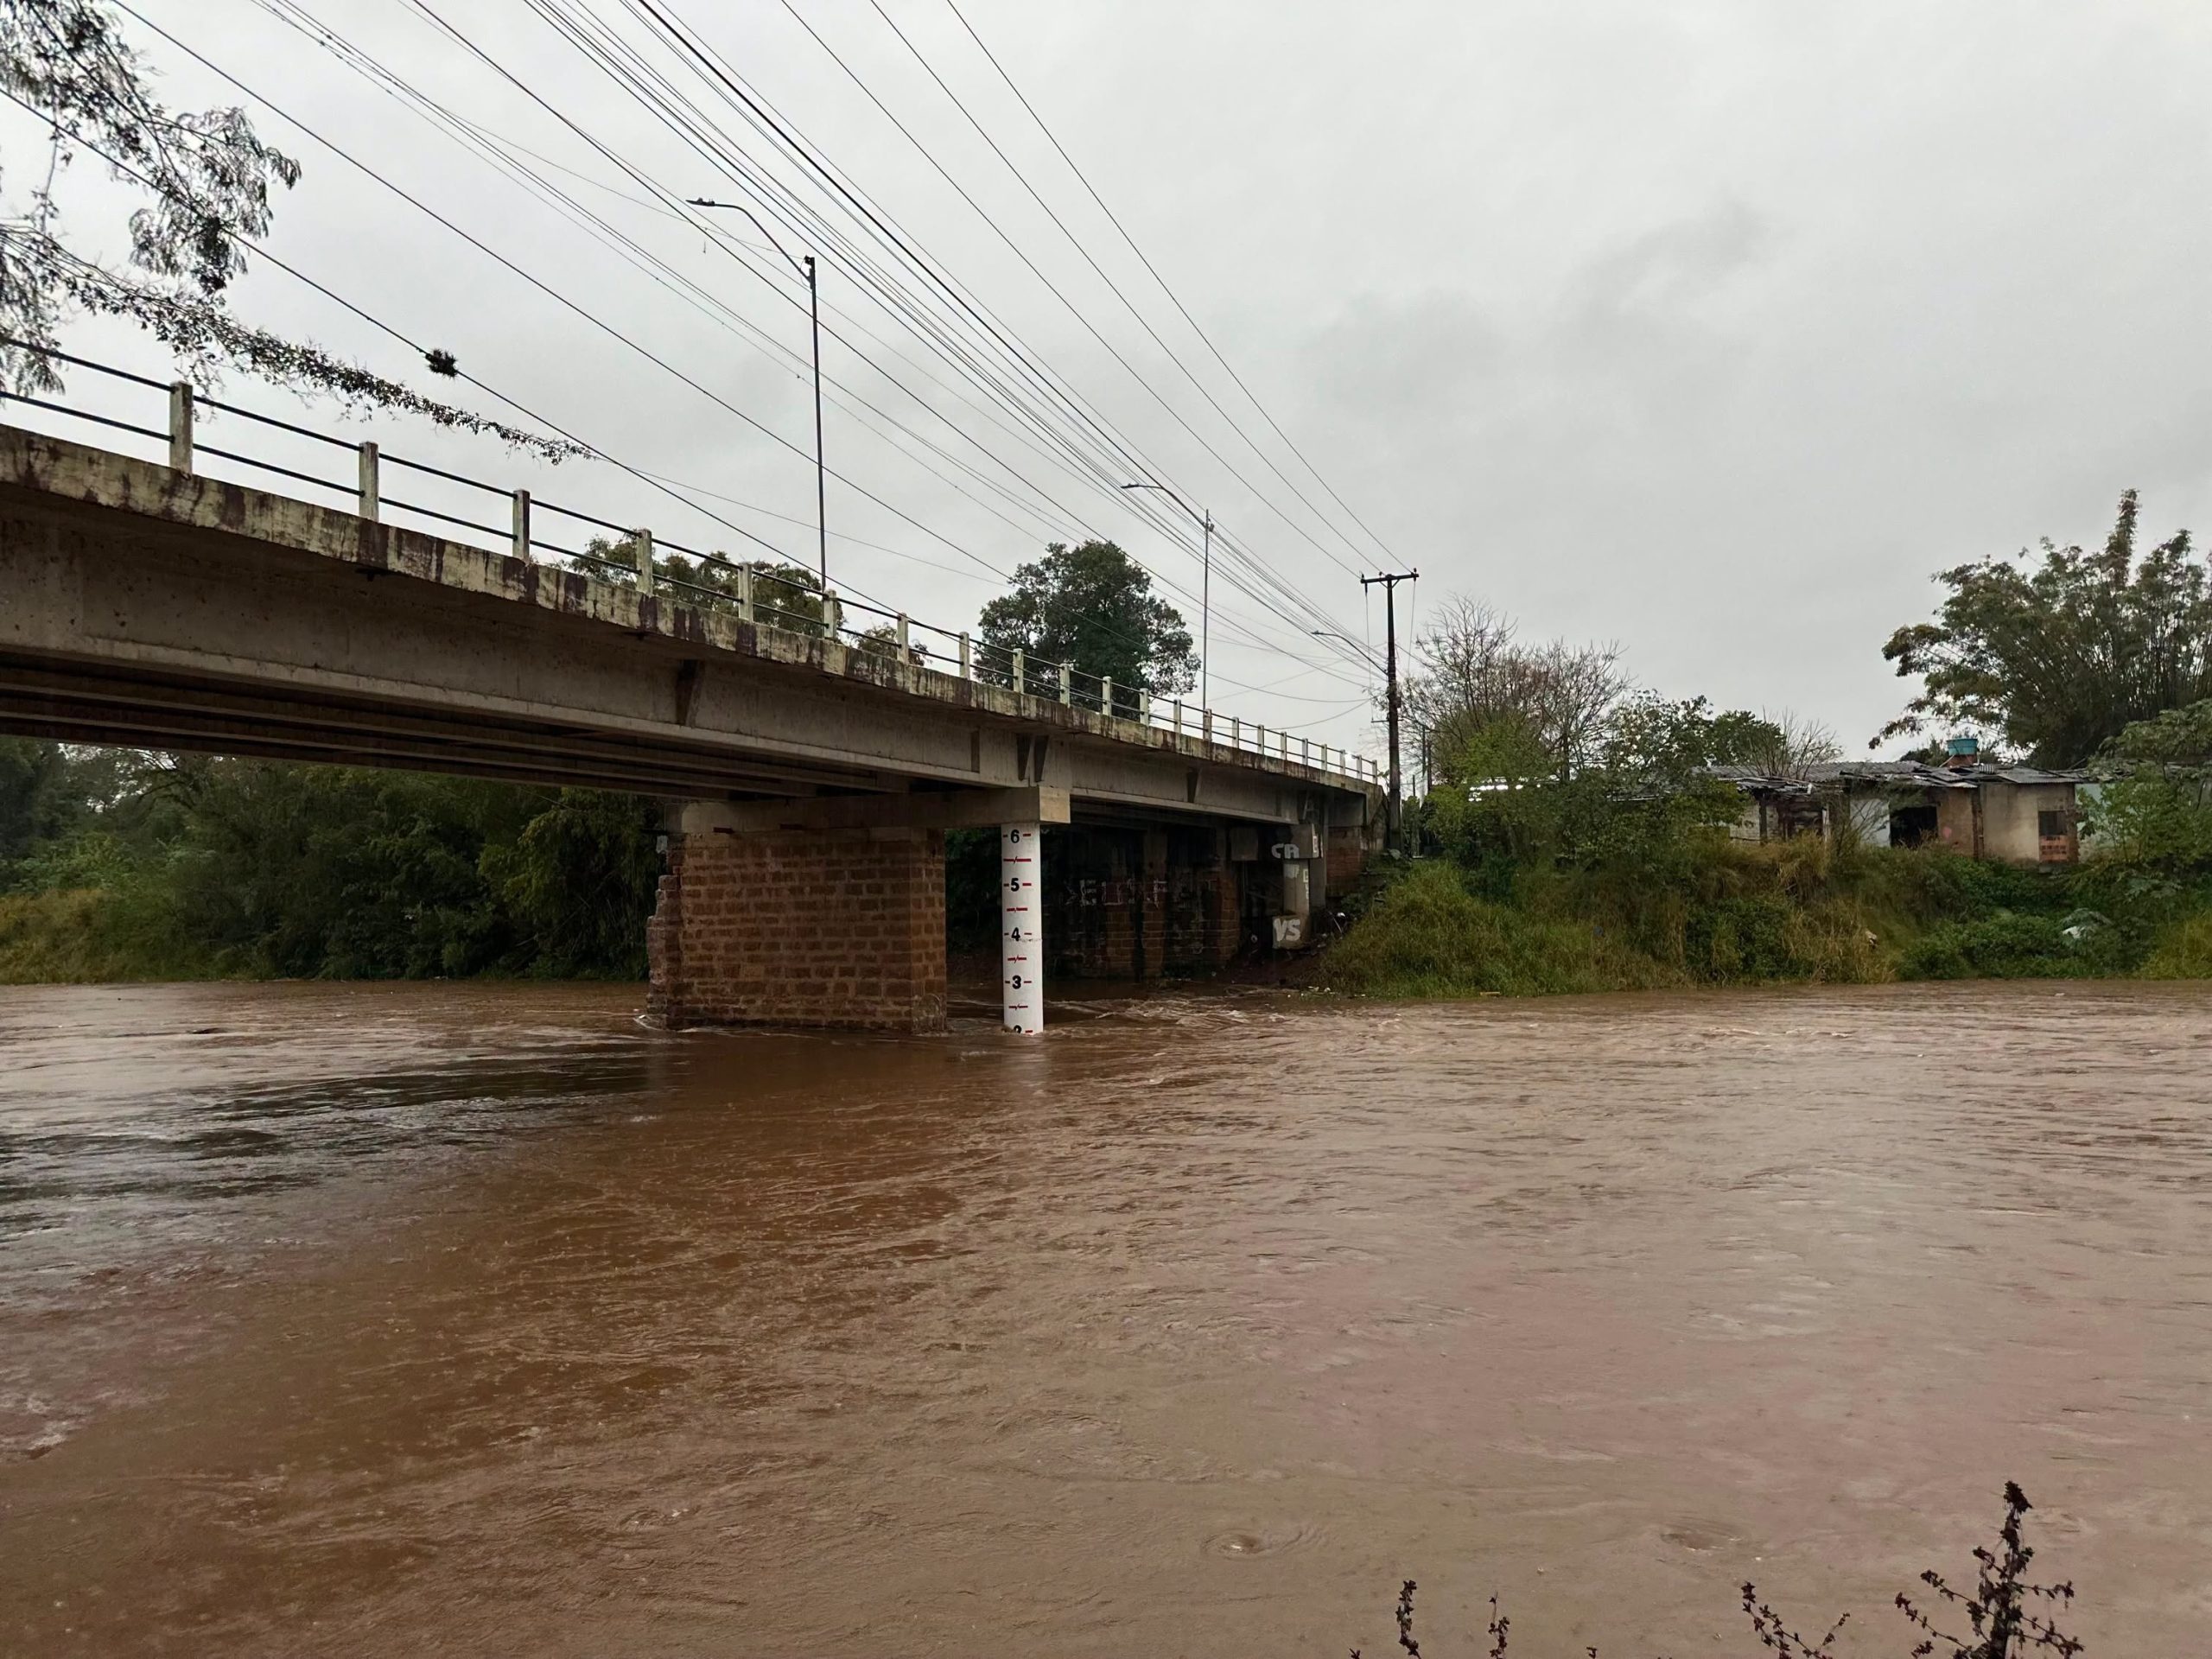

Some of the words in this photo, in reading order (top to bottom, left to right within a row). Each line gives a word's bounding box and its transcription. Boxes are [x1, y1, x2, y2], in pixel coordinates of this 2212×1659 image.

[1011, 830, 1020, 844] 6
[1011, 877, 1020, 892] 5
[1011, 927, 1020, 942] 4
[1274, 918, 1300, 942] VS
[1012, 976, 1021, 989] 3
